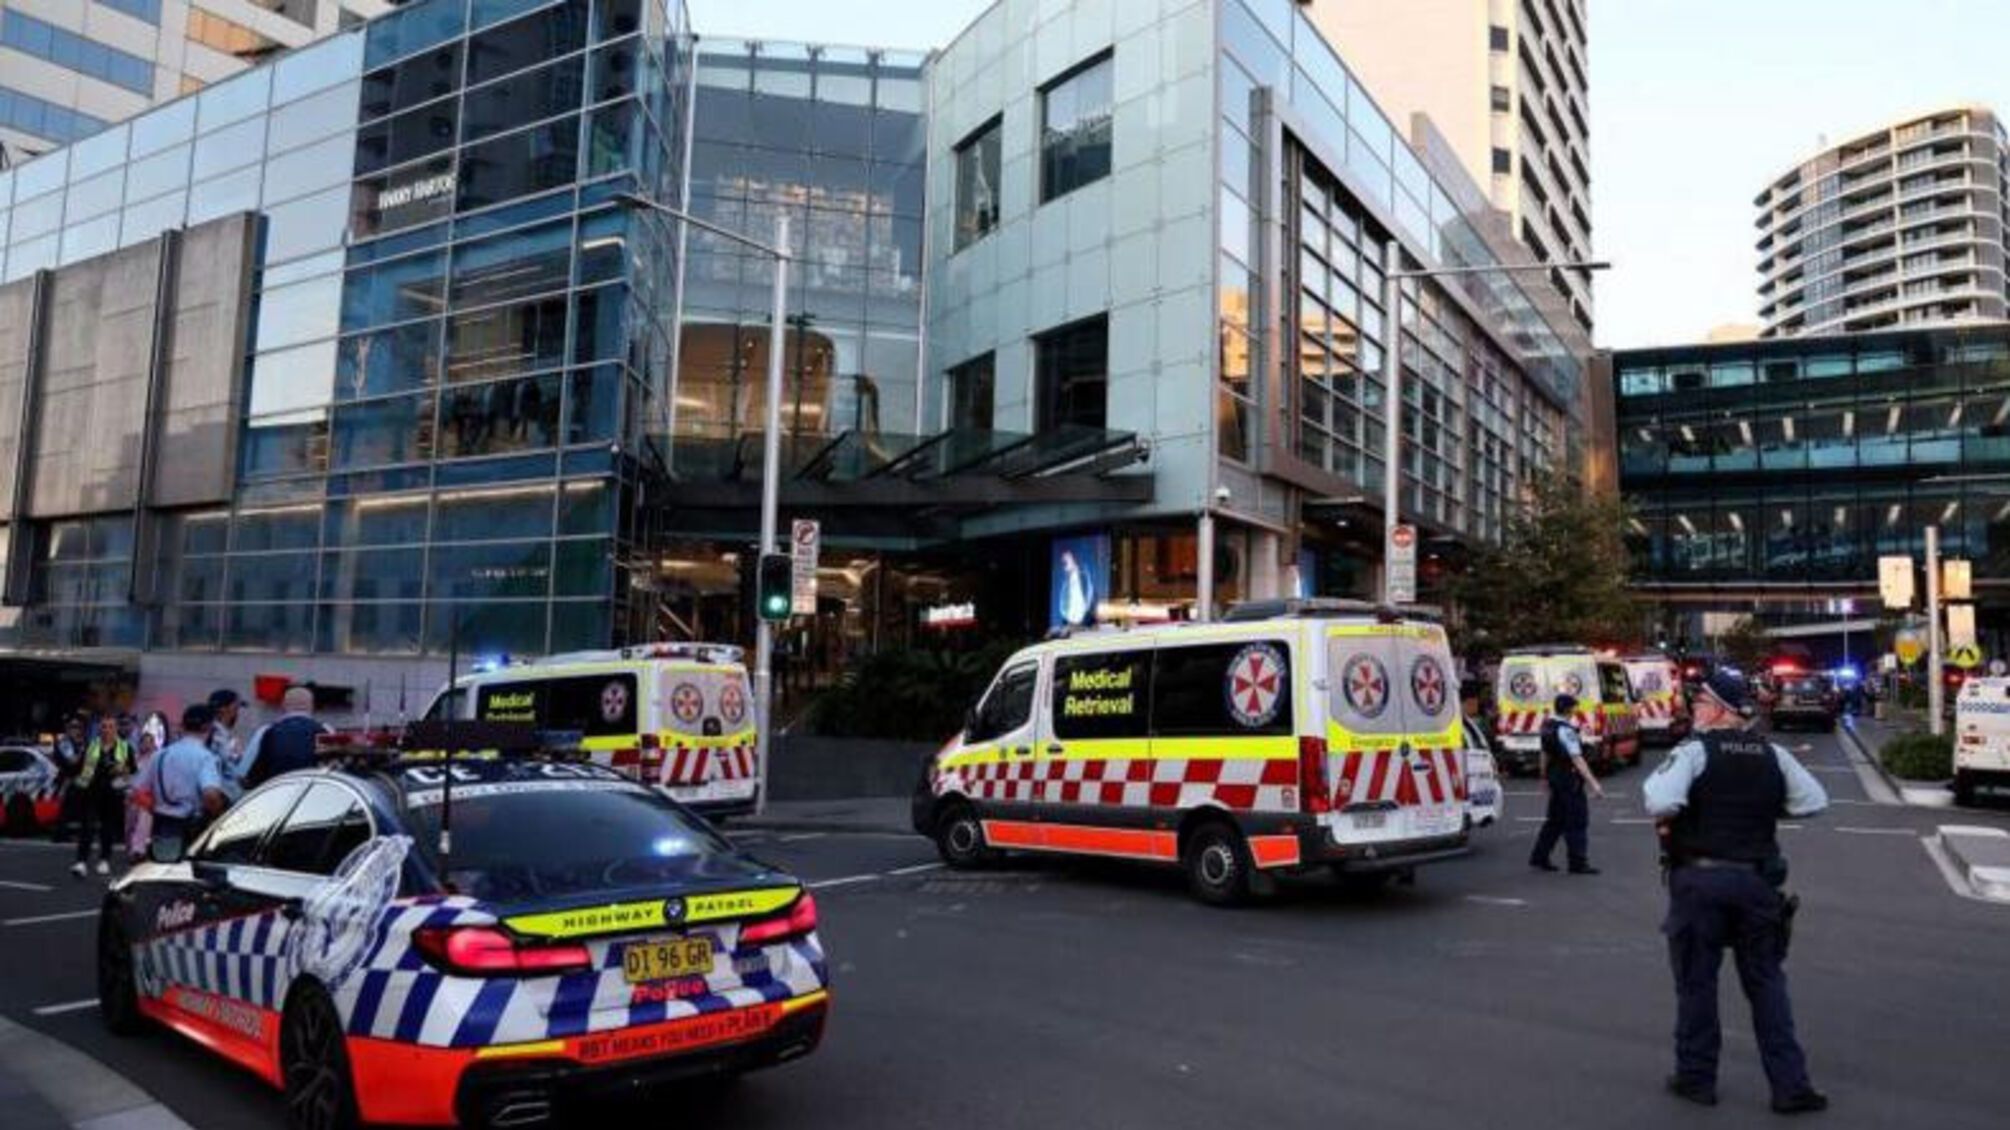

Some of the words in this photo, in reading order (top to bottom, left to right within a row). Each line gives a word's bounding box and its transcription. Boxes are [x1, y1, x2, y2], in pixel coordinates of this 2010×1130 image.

[1070, 665, 1132, 691] Medical
[489, 692, 535, 710] Medical
[1064, 692, 1134, 717] Retrieval
[1720, 741, 1763, 755] POLICE
[156, 898, 196, 929] Police
[562, 909, 654, 929] HIGHWAY
[695, 899, 753, 915] PATROL
[657, 944, 681, 970] 96
[633, 978, 706, 1003] Police
